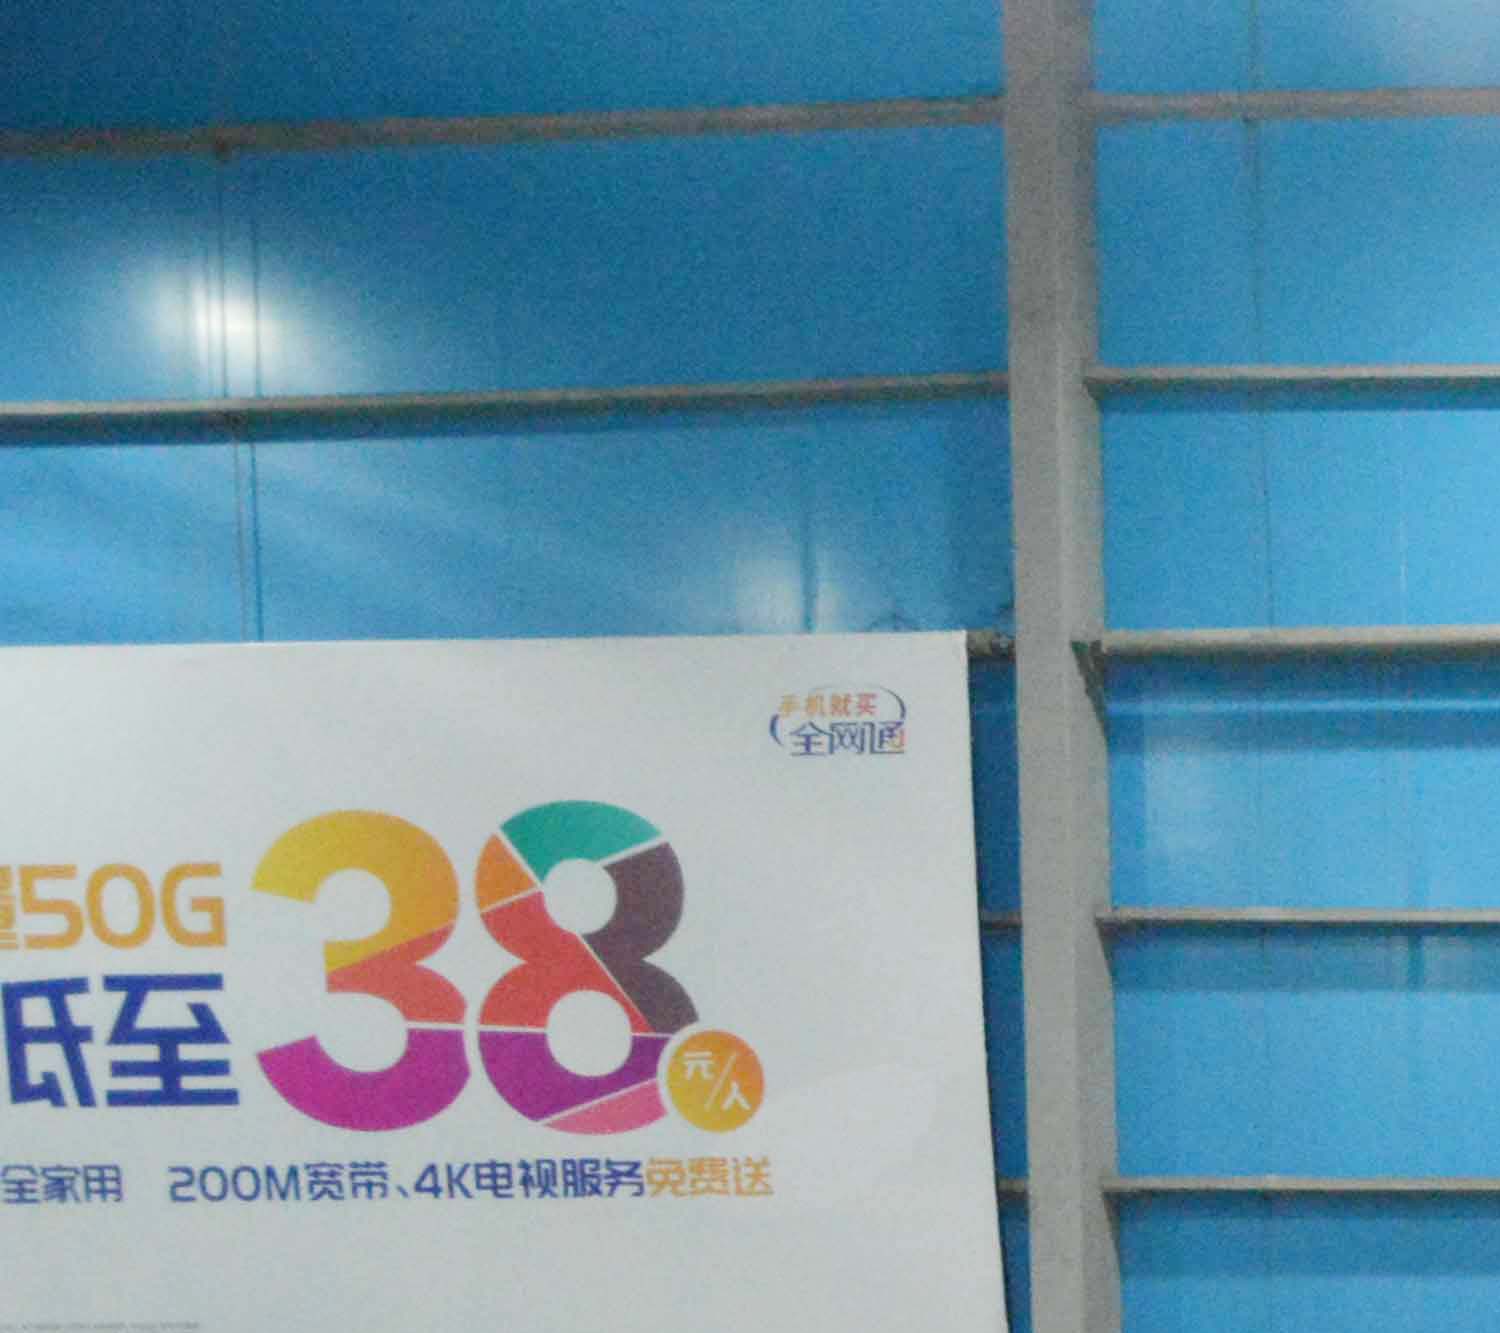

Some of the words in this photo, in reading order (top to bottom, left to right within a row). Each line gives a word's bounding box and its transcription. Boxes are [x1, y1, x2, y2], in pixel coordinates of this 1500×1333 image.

[789, 720, 905, 757] 全网通
[0, 862, 227, 950] 50G
[251, 801, 698, 1136] 38
[0, 1163, 123, 1204] 全家用
[166, 1156, 775, 1203] 200M宽带、4K电视服务免费送
